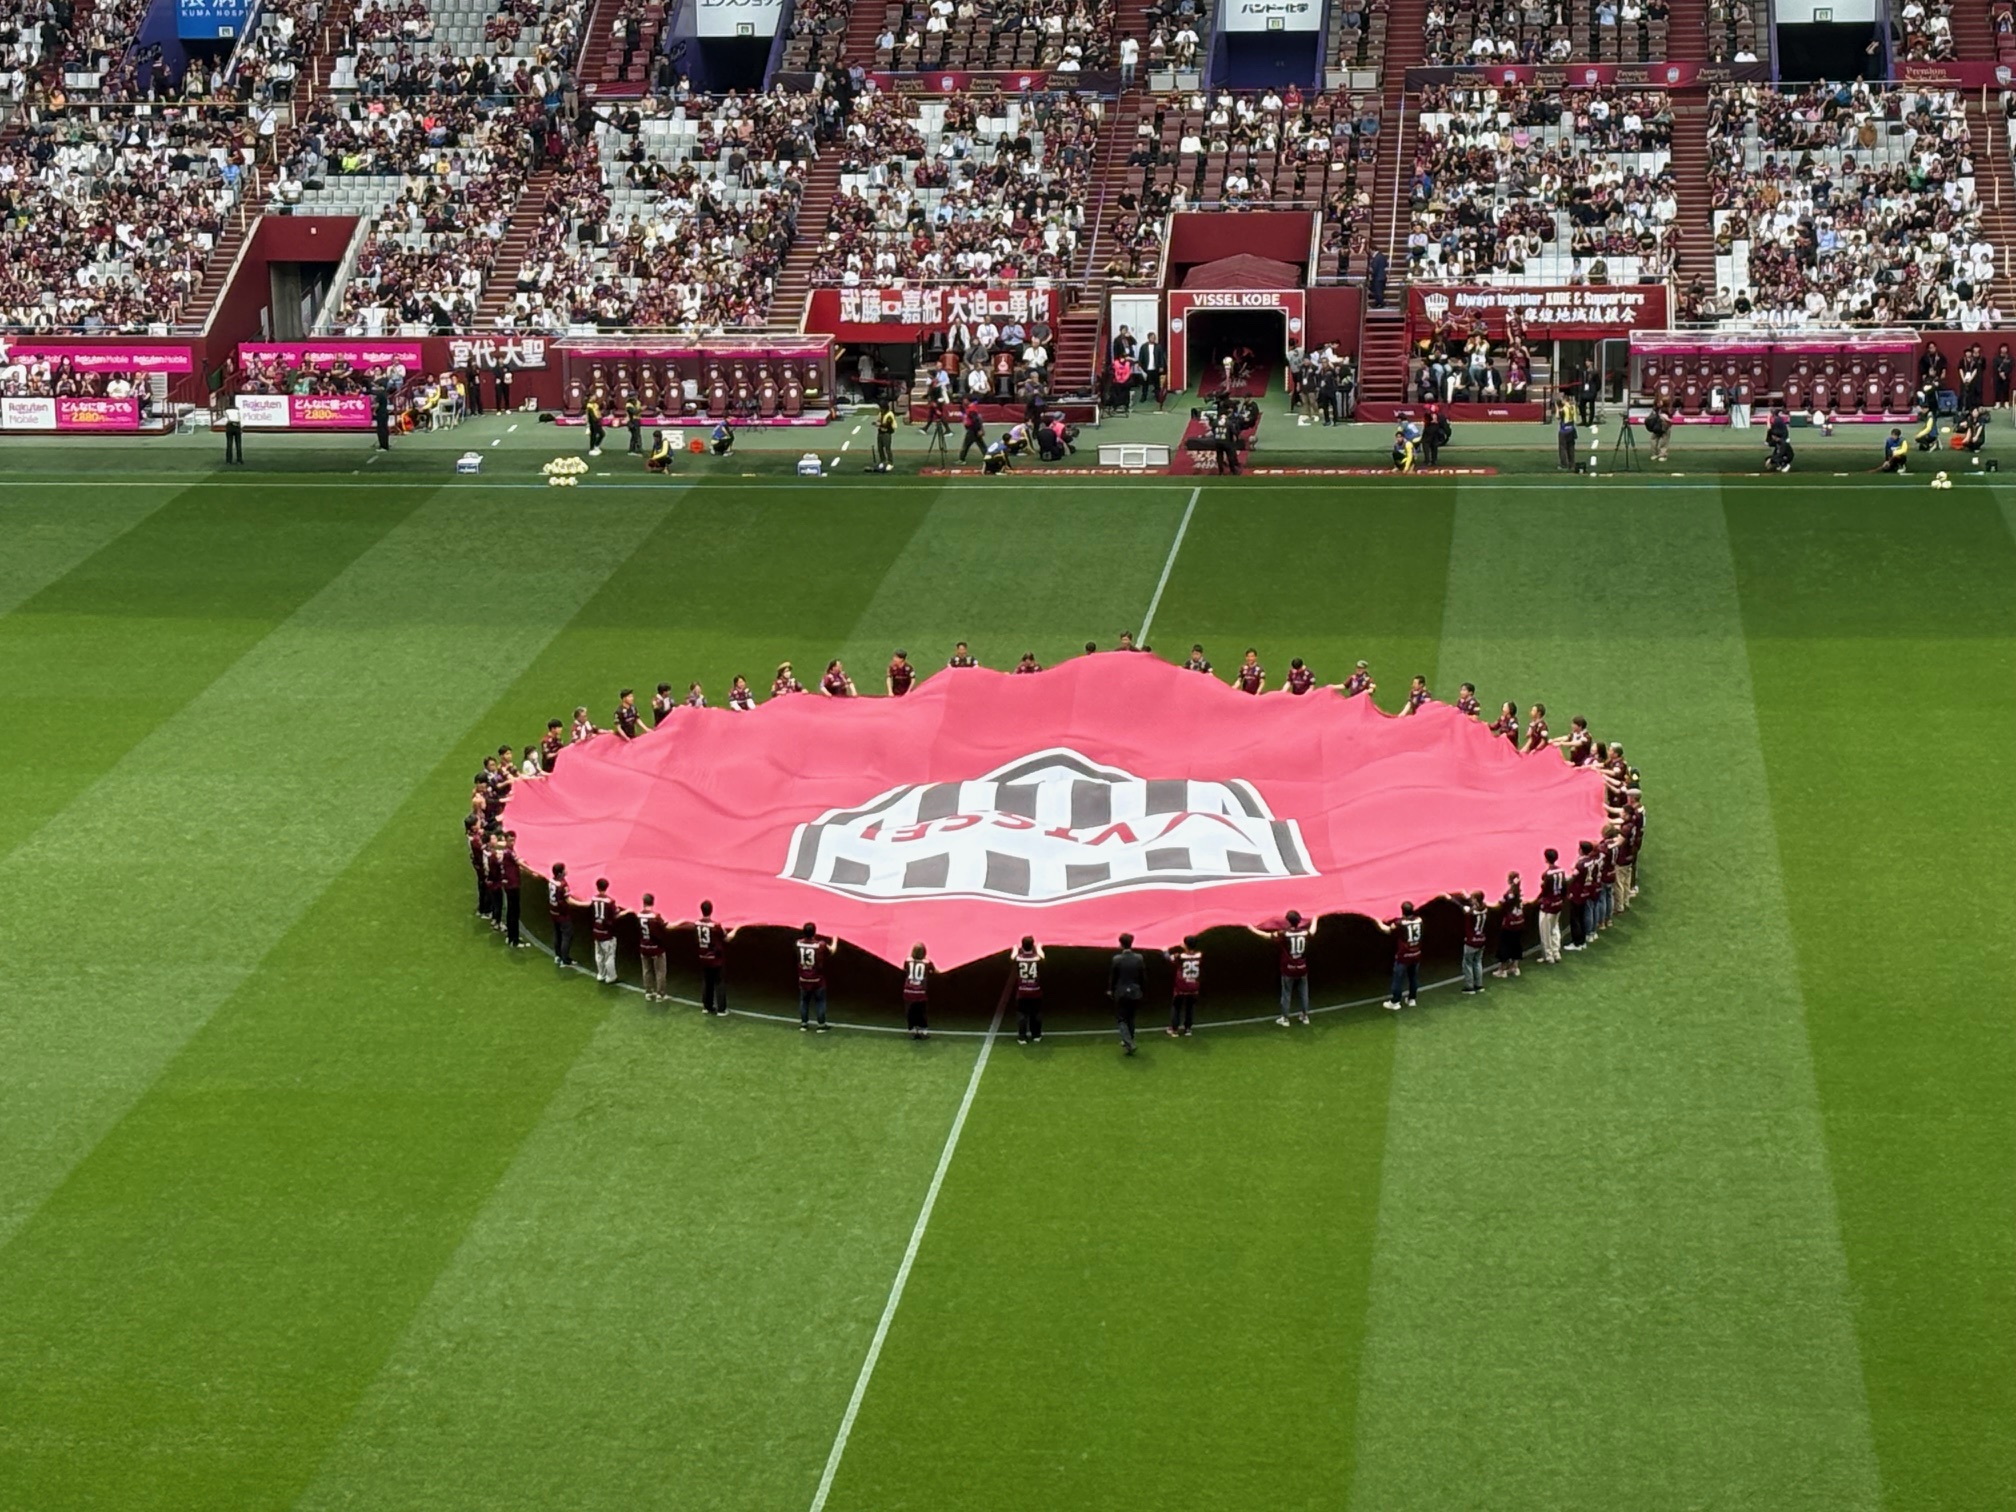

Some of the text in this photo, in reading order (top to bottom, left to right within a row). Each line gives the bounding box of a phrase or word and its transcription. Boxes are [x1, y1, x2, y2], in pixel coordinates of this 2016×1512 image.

[181, 9, 211, 17] KUMA
[1241, 3, 1309, 14] バンドー化学
[948, 289, 988, 323] 大迫
[1192, 293, 1280, 306] VISSEL KOBE
[1455, 293, 1495, 308] Always
[1497, 293, 1543, 307] together
[1546, 292, 1572, 306] KOBE
[1584, 291, 1645, 307] Supporters
[449, 338, 546, 369] 宮代大聖
[8, 402, 49, 414] Rakuten
[61, 401, 133, 413] どんなに使っても
[242, 400, 282, 411] Rakuten
[294, 399, 365, 410] どんなに使っても
[9, 414, 39, 424] Mobile
[242, 412, 272, 421] Mobile
[594, 902, 605, 919] 11
[640, 918, 650, 935] 5
[697, 926, 711, 944] 13
[1407, 924, 1421, 942] 13
[1290, 937, 1306, 954] 10
[799, 949, 815, 966] 13
[908, 962, 925, 981] 10
[1018, 962, 1038, 979] 24
[1182, 960, 1200, 978] 25
